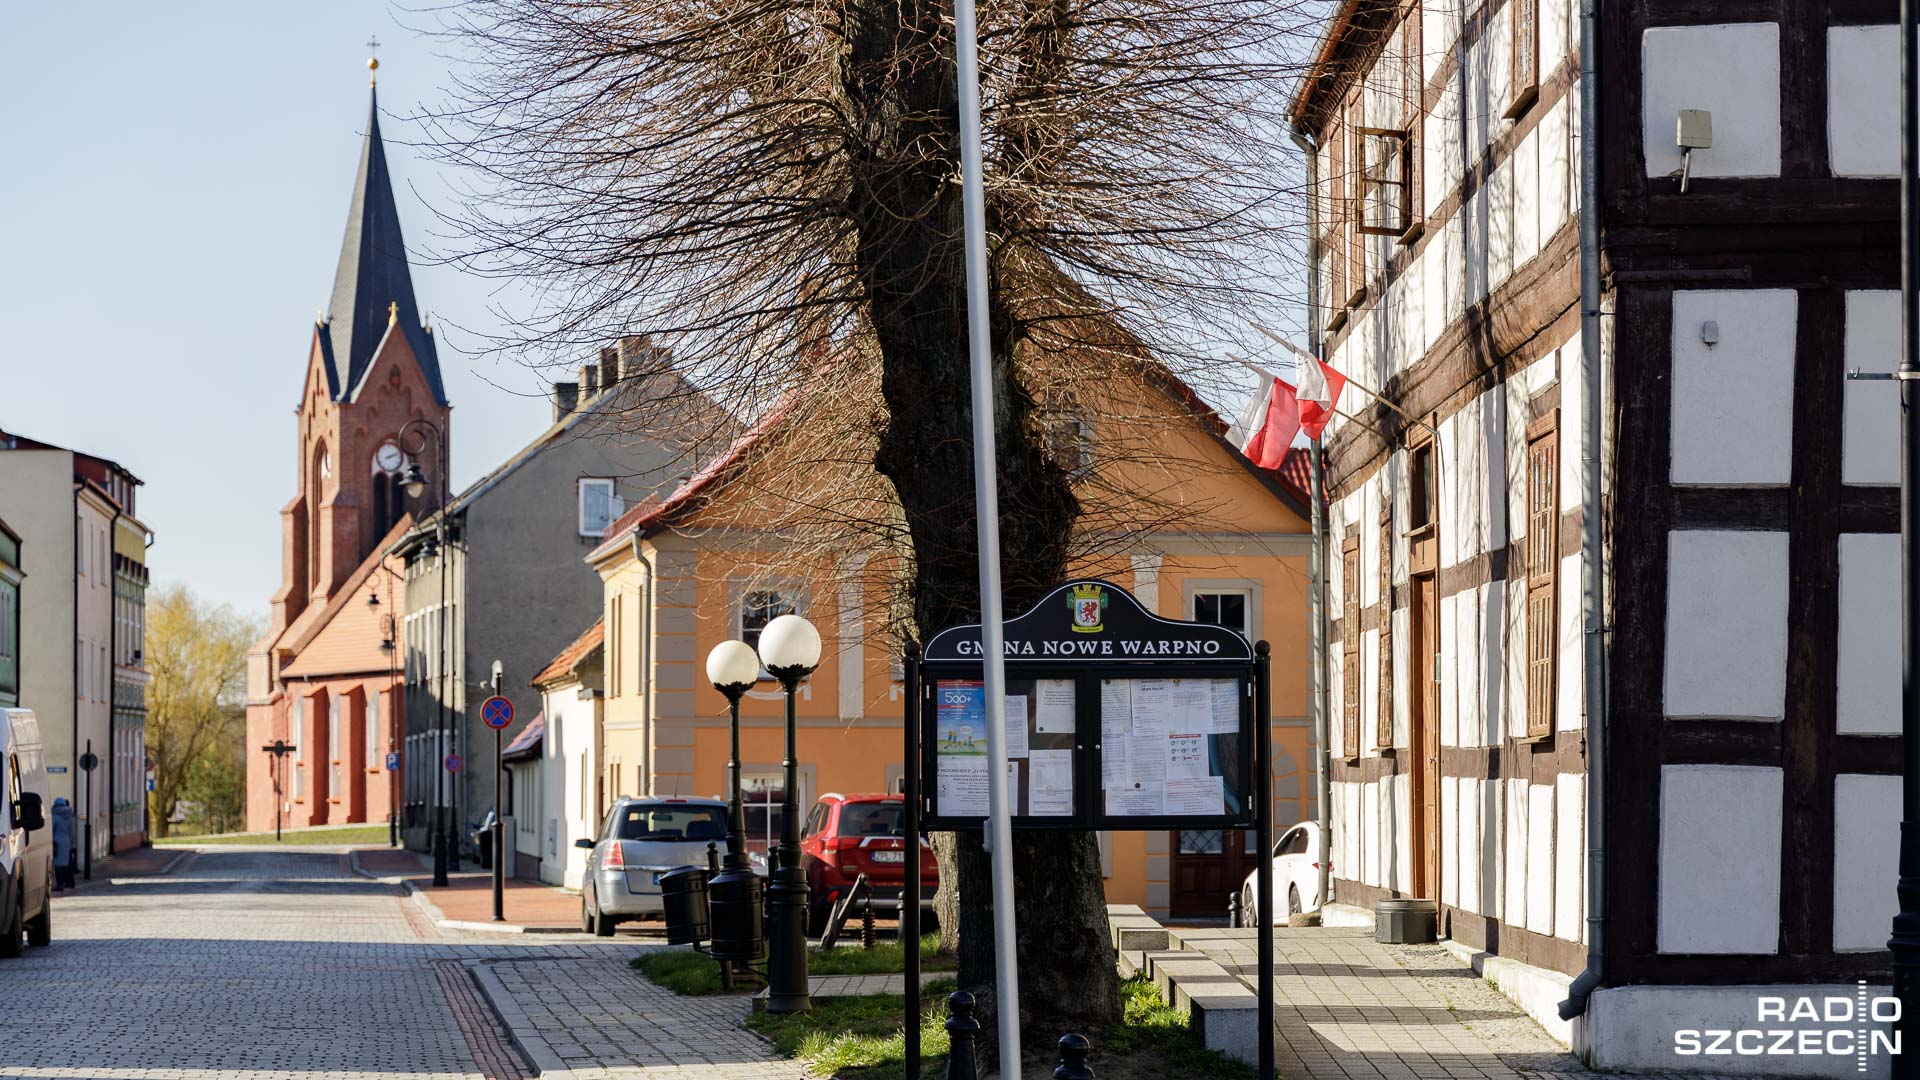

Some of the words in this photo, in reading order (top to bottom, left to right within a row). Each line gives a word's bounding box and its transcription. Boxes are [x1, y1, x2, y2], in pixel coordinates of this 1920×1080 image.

[957, 641, 1036, 655] GMNA
[1043, 641, 1113, 655] NOWE
[1120, 640, 1220, 655] WARPNO
[944, 692, 972, 704] 500+
